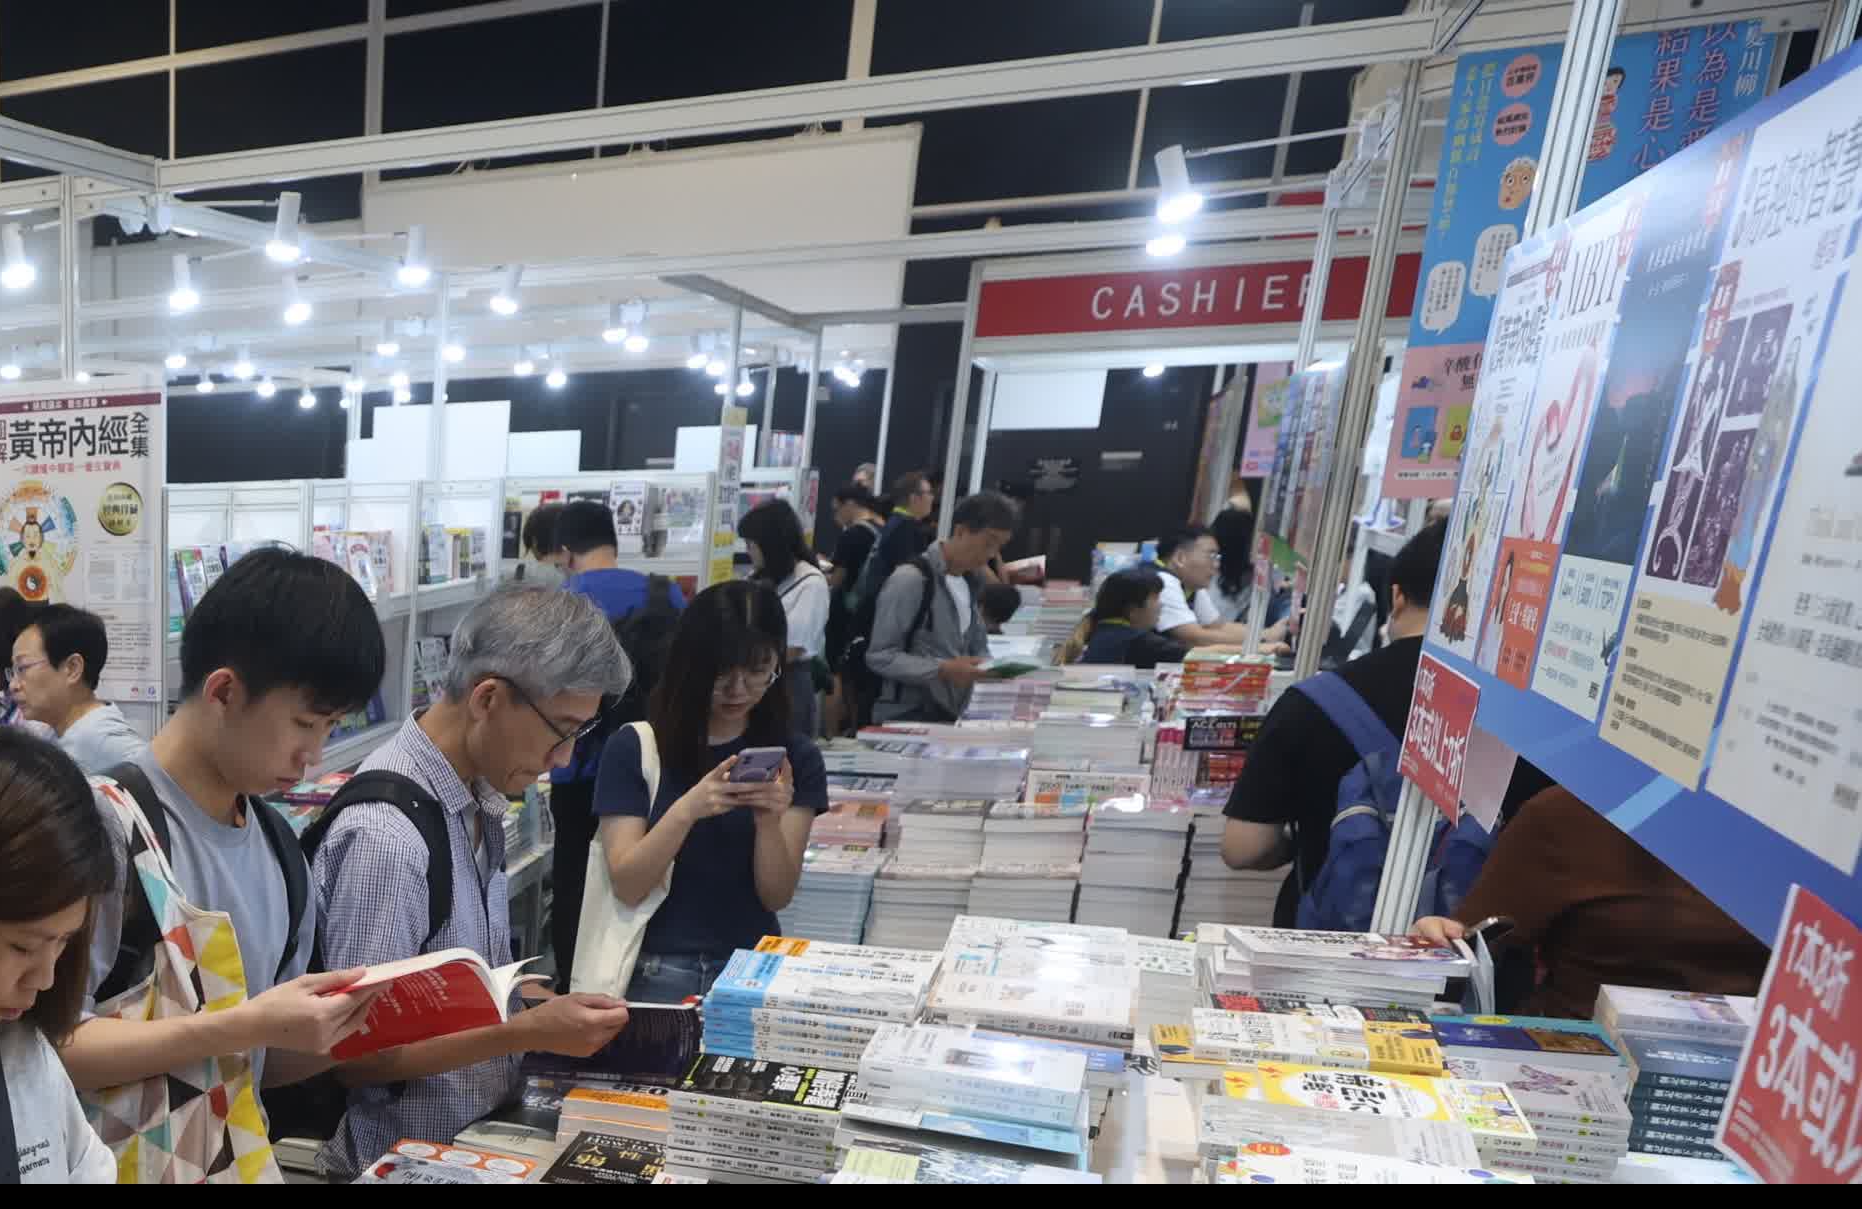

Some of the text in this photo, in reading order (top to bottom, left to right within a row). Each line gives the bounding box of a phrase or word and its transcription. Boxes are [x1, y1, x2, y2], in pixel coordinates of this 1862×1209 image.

[9, 415, 129, 461] 黃帝內經
[130, 411, 150, 458] 全集
[1786, 919, 1855, 1020] 1本8折
